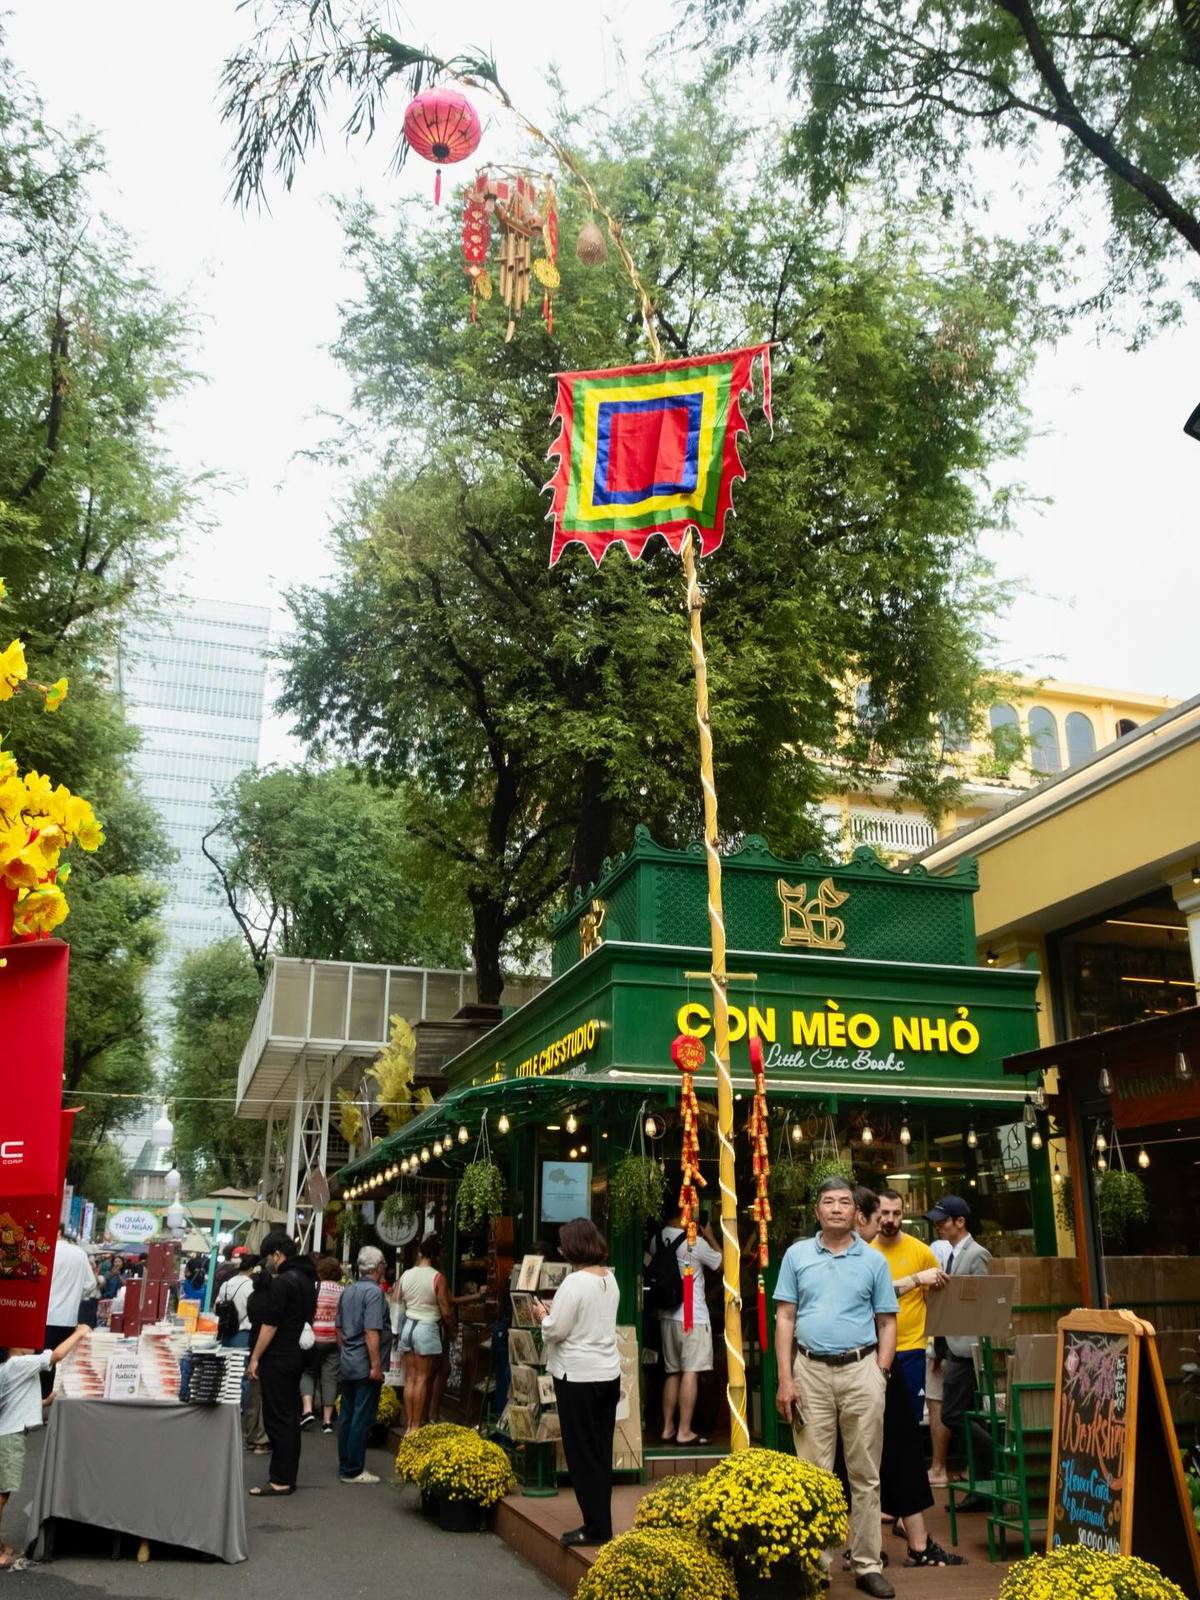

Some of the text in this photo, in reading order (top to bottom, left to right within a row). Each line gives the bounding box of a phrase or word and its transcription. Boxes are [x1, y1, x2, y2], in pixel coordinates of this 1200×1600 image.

[561, 1020, 595, 1062] STUDIO
[677, 999, 980, 1055] CON MÈO NHỎ
[764, 1043, 806, 1068] Little
[18, 1300, 37, 1309] NAM
